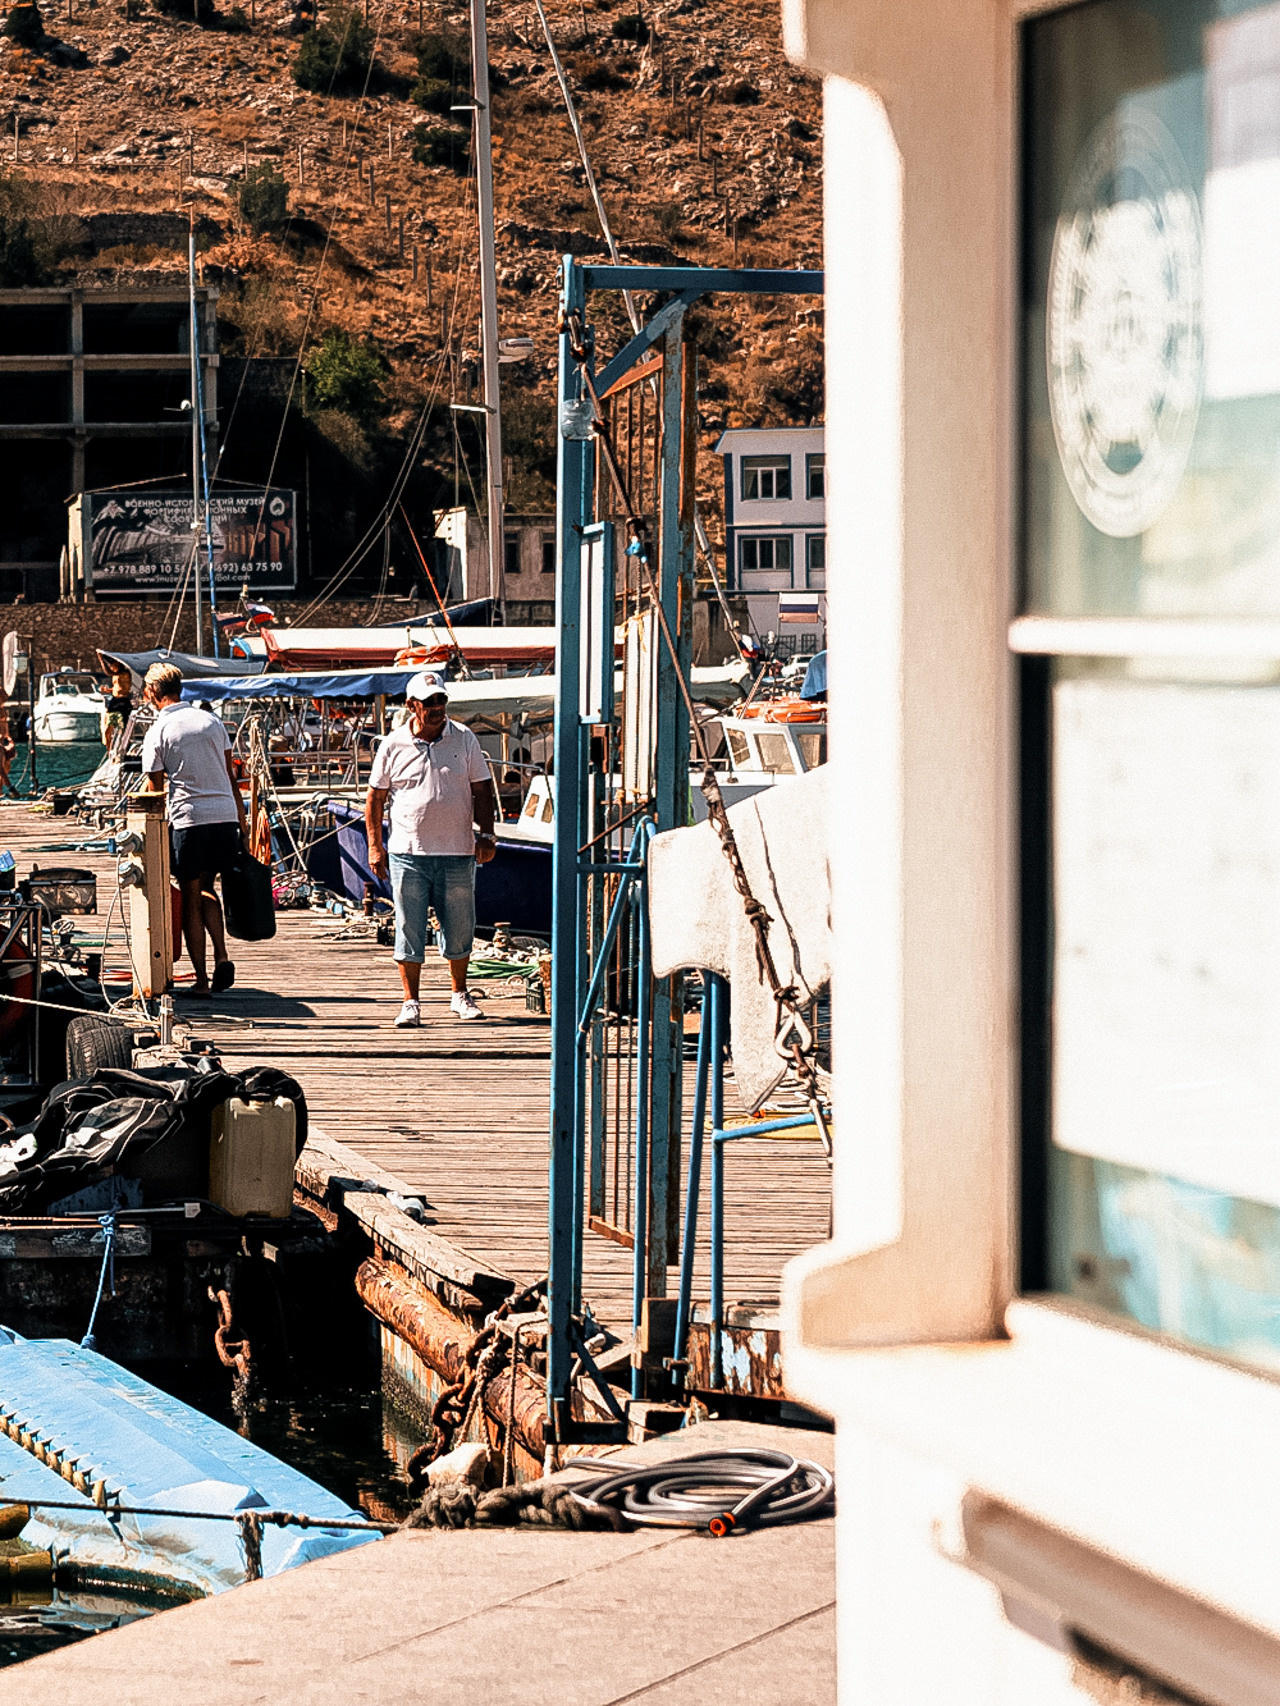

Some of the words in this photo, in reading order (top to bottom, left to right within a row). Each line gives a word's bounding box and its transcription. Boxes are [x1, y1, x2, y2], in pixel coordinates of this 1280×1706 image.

[125, 497, 234, 508] ВОЕННО-ИСТОРЧСКИЙ
[143, 506, 247, 516] ФОРТИФИКЦОННЫХ
[118, 564, 137, 575] 978
[139, 564, 157, 574] 889
[160, 563, 172, 574] 10
[255, 562, 268, 572] 75
[270, 561, 283, 572] 90
